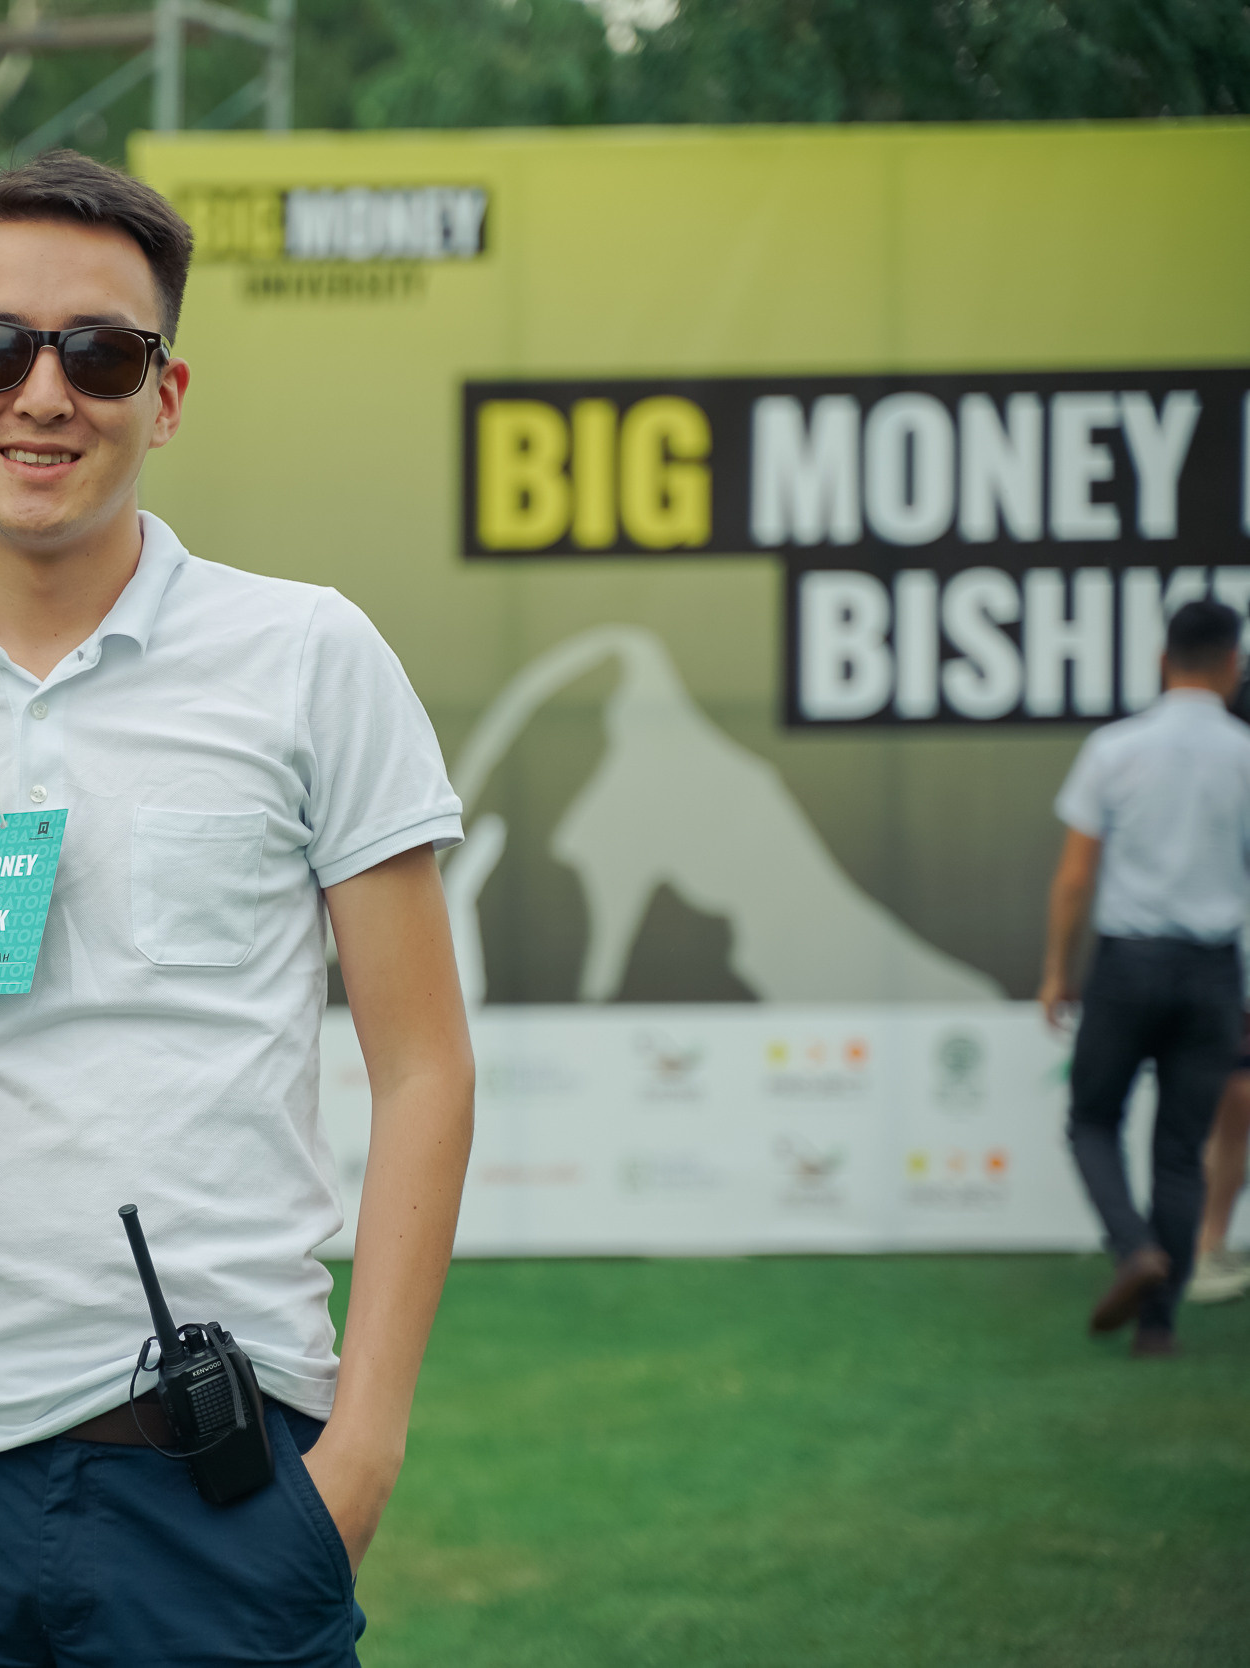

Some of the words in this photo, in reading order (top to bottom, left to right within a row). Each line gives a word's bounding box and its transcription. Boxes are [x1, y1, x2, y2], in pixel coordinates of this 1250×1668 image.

[286, 186, 487, 260] MONEY
[476, 396, 713, 550] BIG
[750, 390, 1201, 547] MONEY
[192, 1360, 222, 1377] KENWOOD
